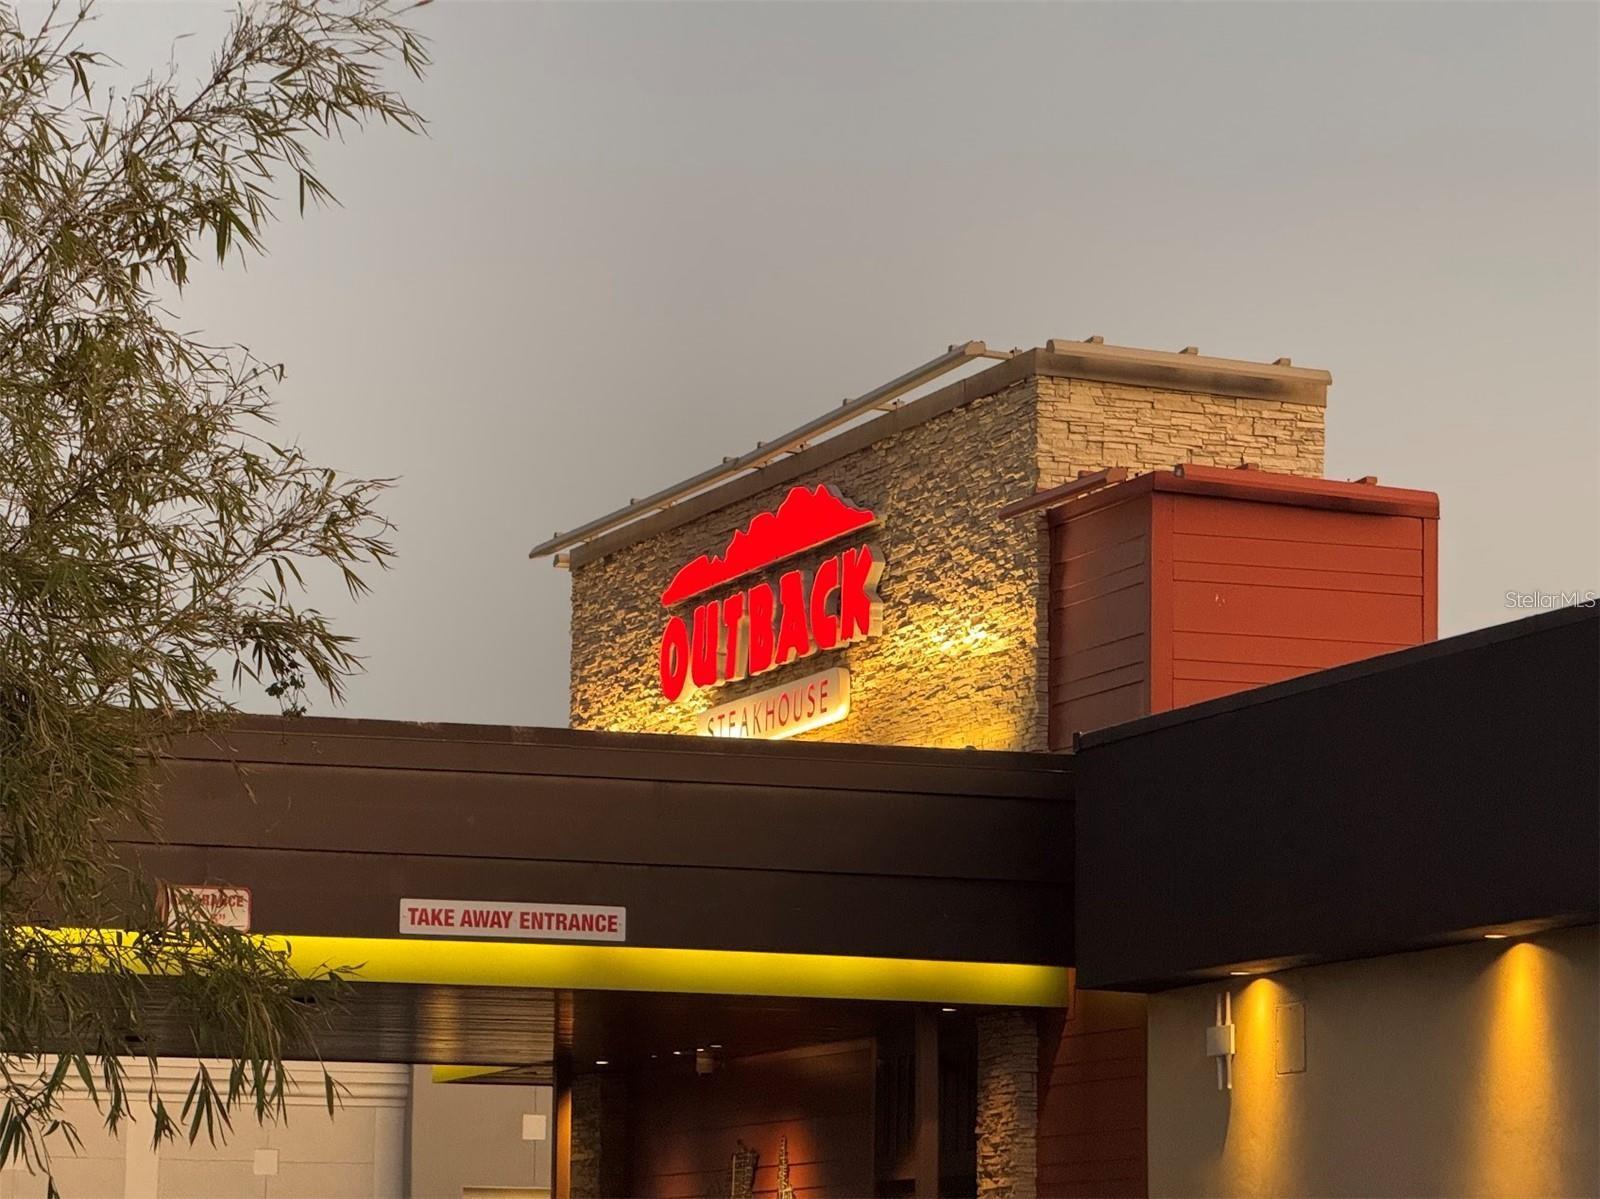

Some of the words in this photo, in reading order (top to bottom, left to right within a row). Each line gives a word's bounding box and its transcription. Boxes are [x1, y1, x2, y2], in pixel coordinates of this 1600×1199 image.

[660, 544, 873, 702] OUTBACK
[707, 680, 828, 737] STEAKHOUSE
[407, 907, 455, 927] TAKE
[459, 909, 513, 929] AWAY
[519, 911, 618, 933] ENTRANCE
